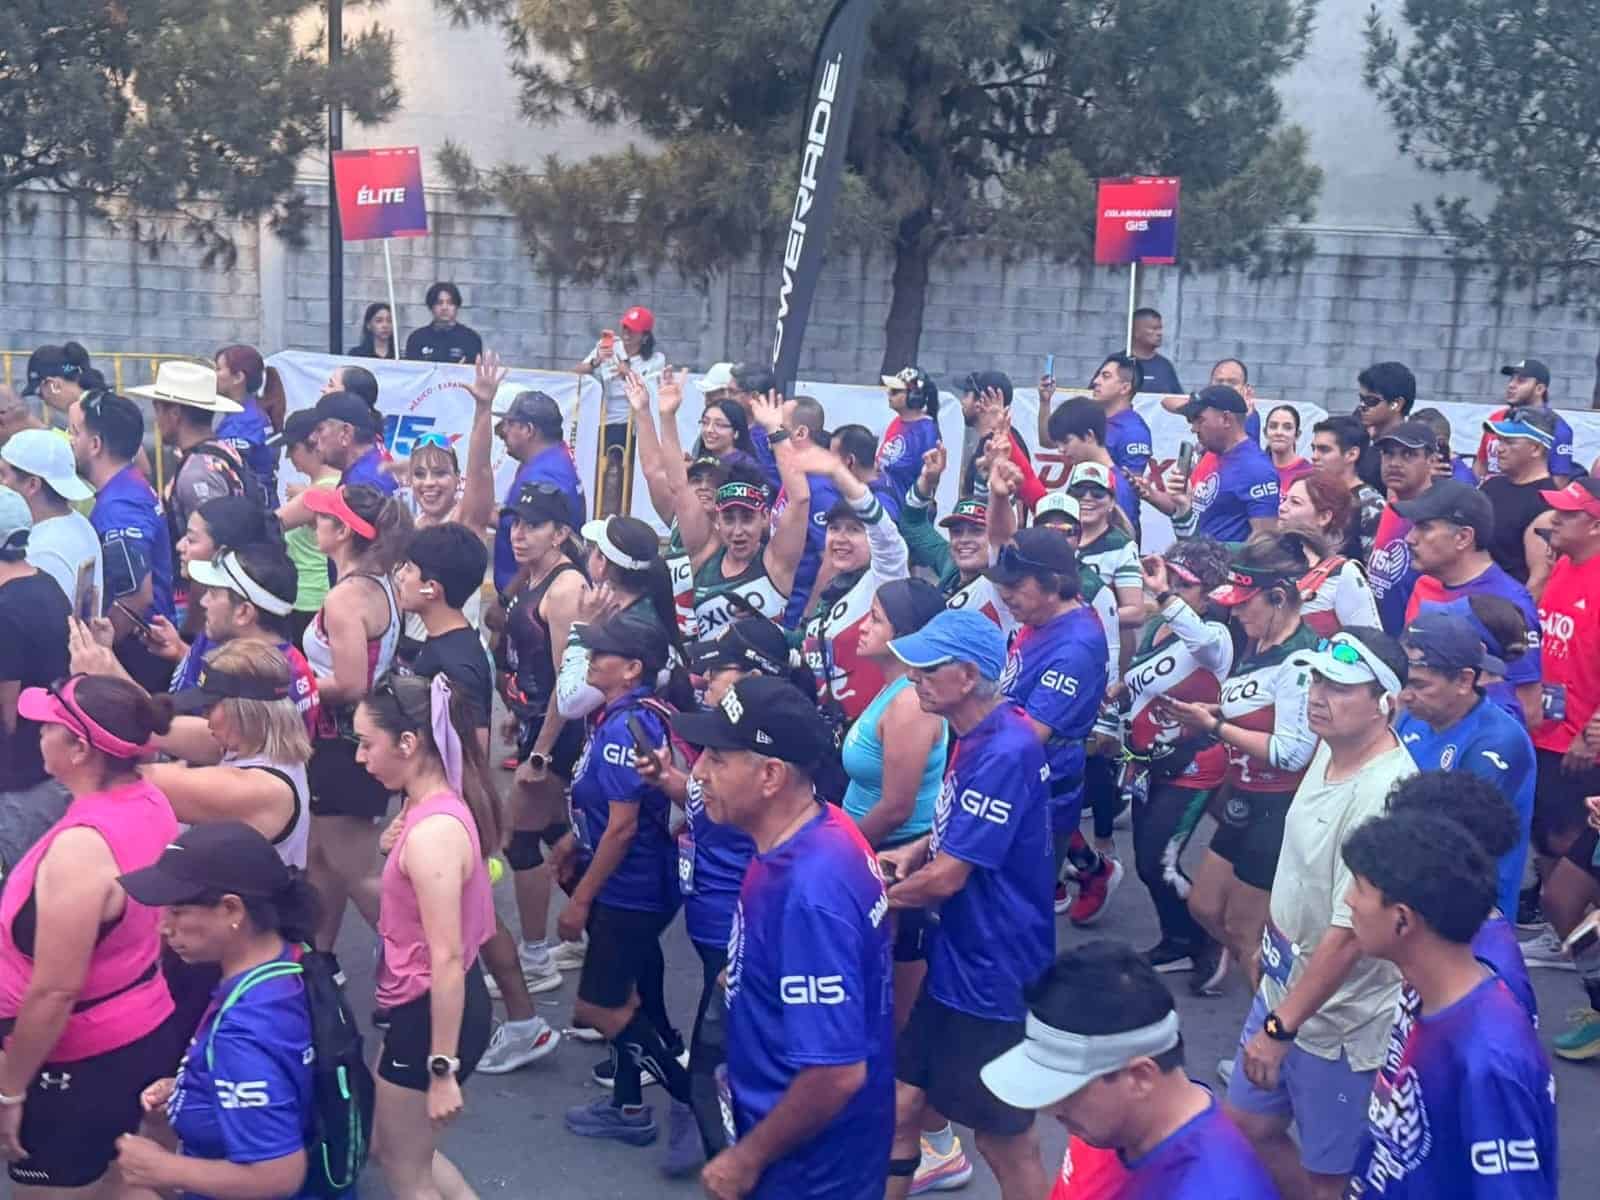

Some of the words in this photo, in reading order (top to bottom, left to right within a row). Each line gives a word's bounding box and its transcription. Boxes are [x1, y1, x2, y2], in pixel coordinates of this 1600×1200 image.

[356, 184, 406, 206] ÉLITE
[771, 56, 841, 373] OWERADE
[1125, 220, 1149, 232] GIS
[1249, 481, 1279, 500] GIS
[1040, 669, 1080, 697] GIS
[603, 742, 638, 768] GIS
[959, 788, 1013, 826] GIS
[780, 975, 846, 1005] GIS
[1470, 1137, 1541, 1175] GIS
